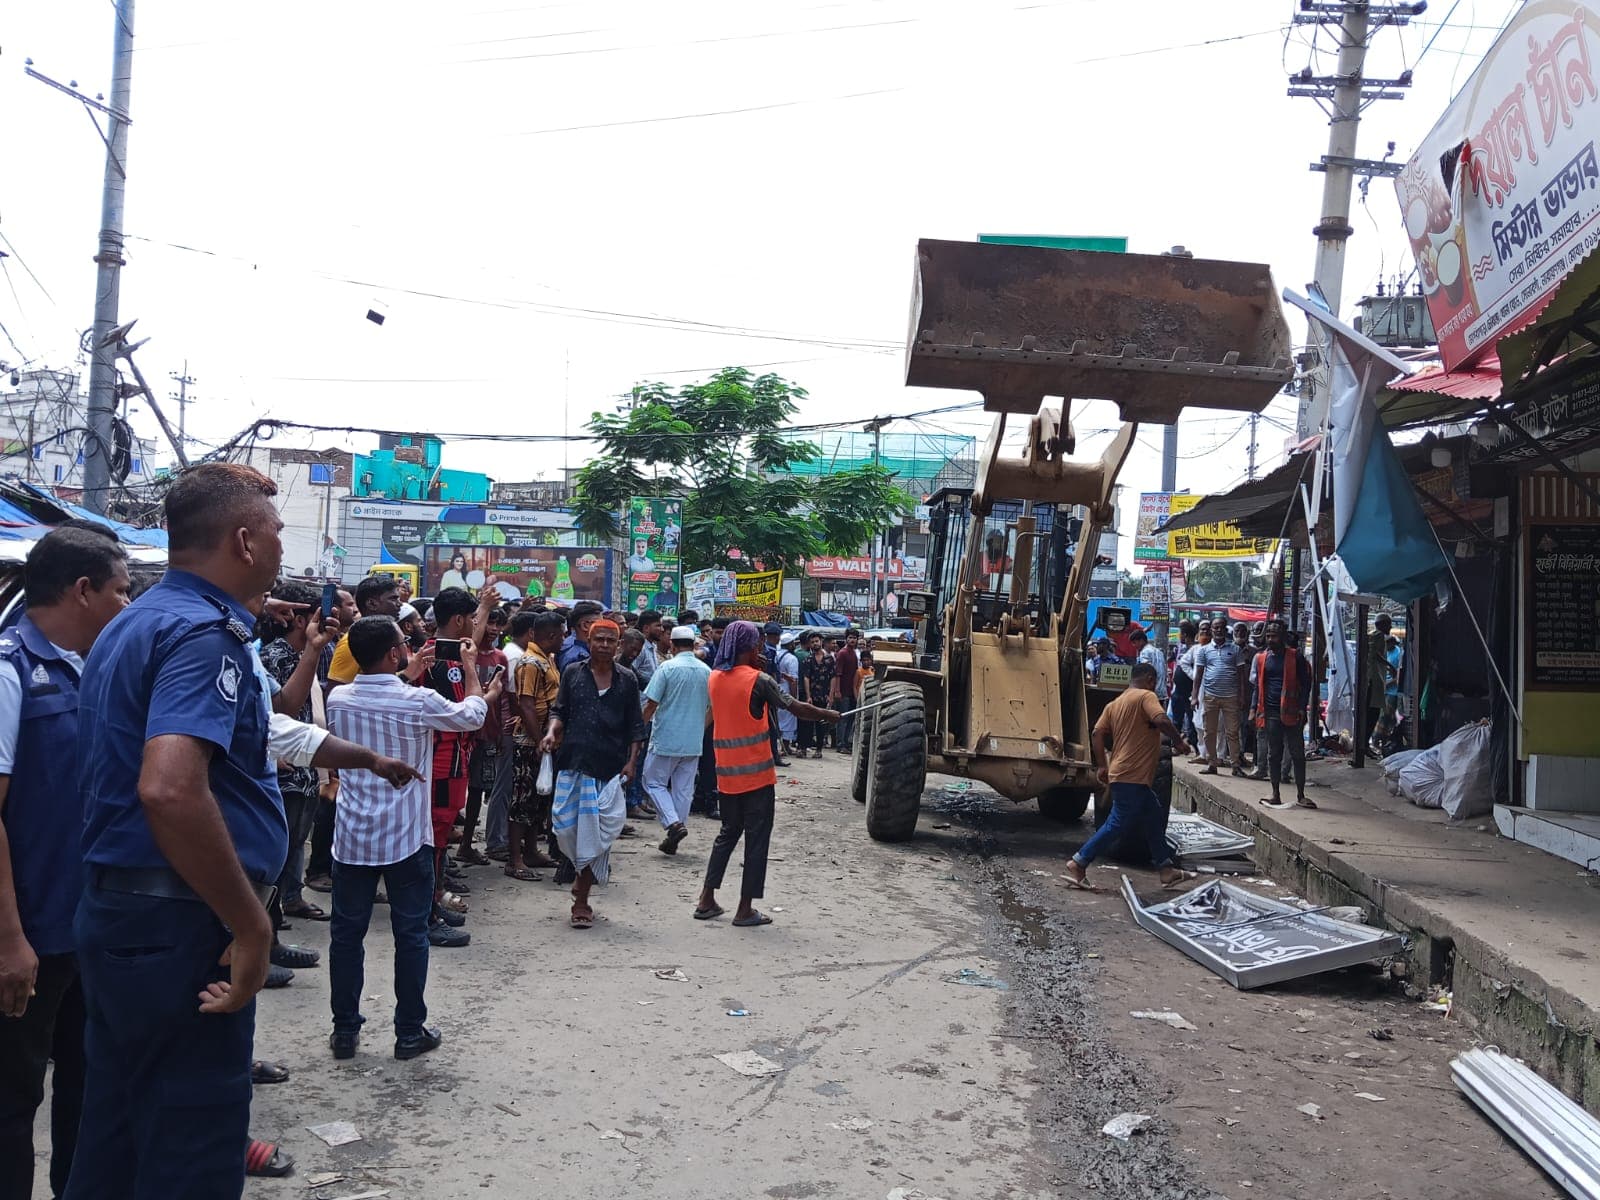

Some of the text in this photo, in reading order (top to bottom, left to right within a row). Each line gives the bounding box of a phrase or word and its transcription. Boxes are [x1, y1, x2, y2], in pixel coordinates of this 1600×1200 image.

[1461, 82, 1537, 207] দয়াল
[1492, 140, 1599, 266] মিষ্টান্ন ভান্ডার
[1509, 260, 1525, 284] সেরা
[1525, 239, 1550, 269] মিষ্টির
[813, 559, 834, 567] beko
[837, 559, 898, 574] WALTON
